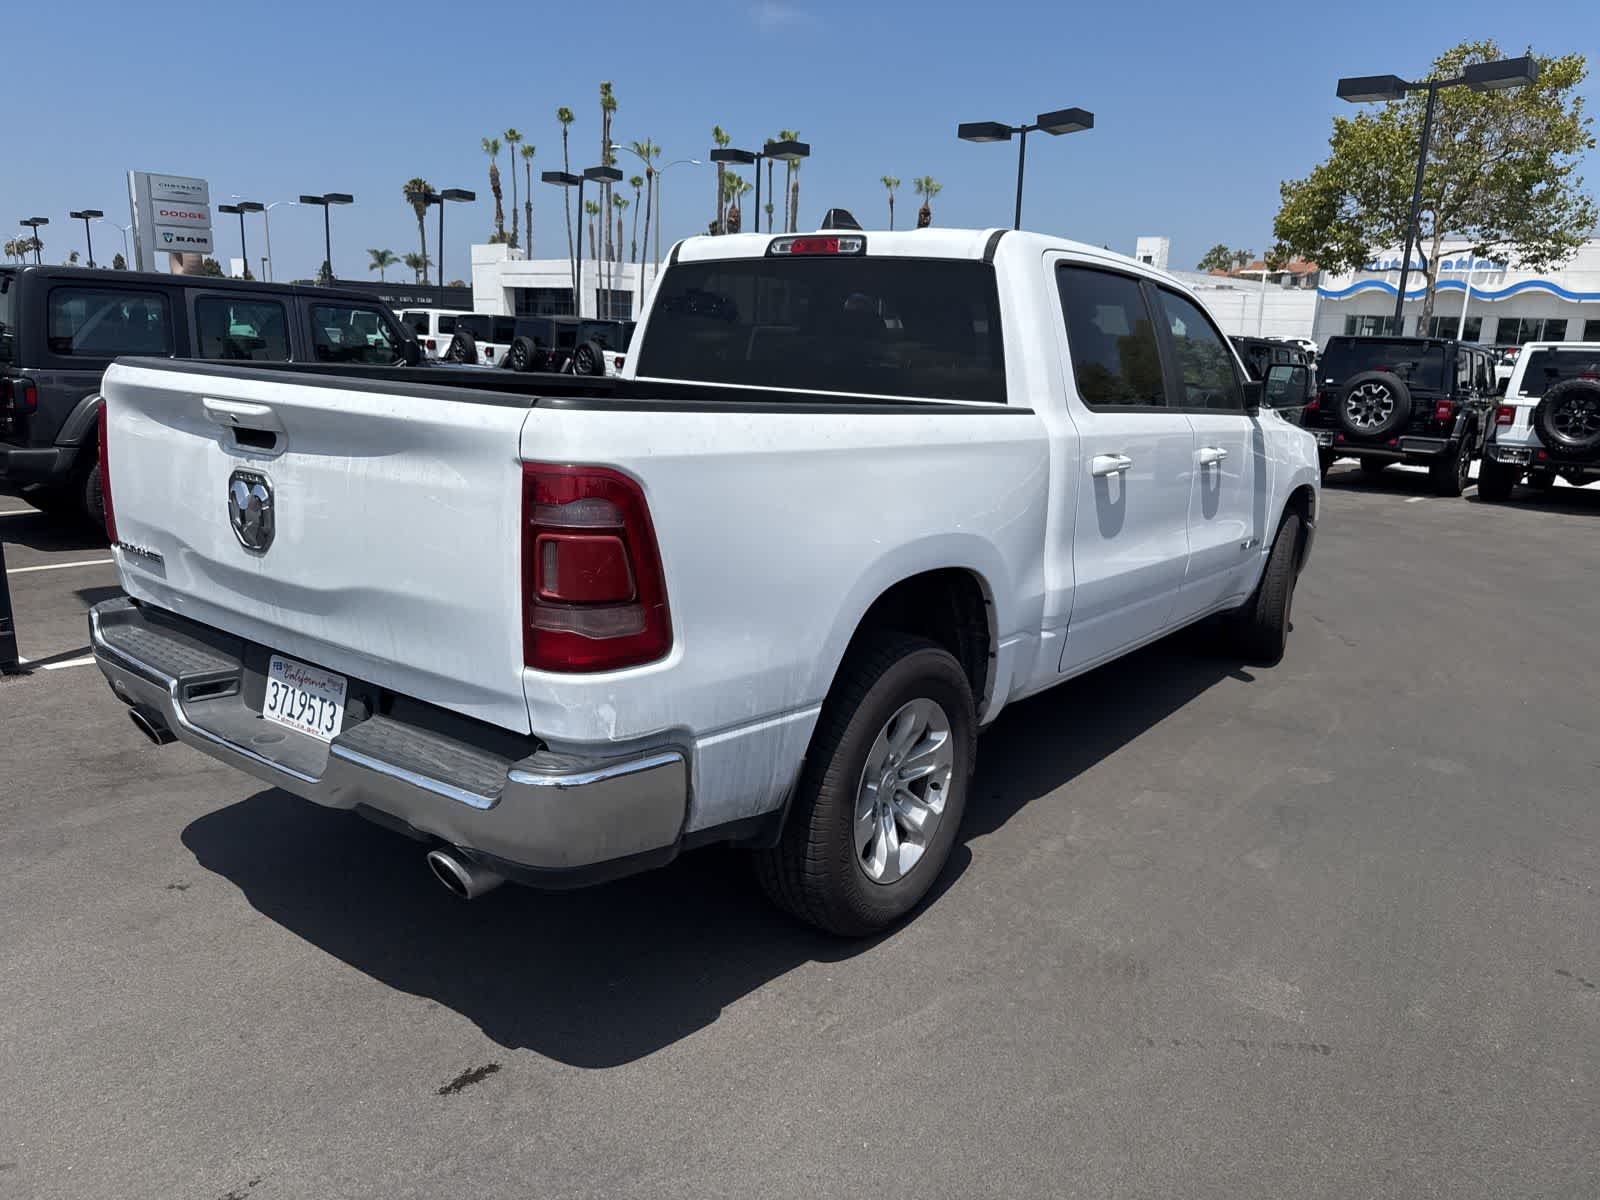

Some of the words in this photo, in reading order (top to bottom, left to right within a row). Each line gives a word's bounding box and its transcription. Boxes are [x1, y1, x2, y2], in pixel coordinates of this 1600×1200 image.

[160, 210, 206, 220] DODGE
[176, 236, 208, 244] RAM
[1362, 255, 1508, 272] utoation
[283, 663, 327, 690] California
[268, 681, 337, 732] 37195T3
